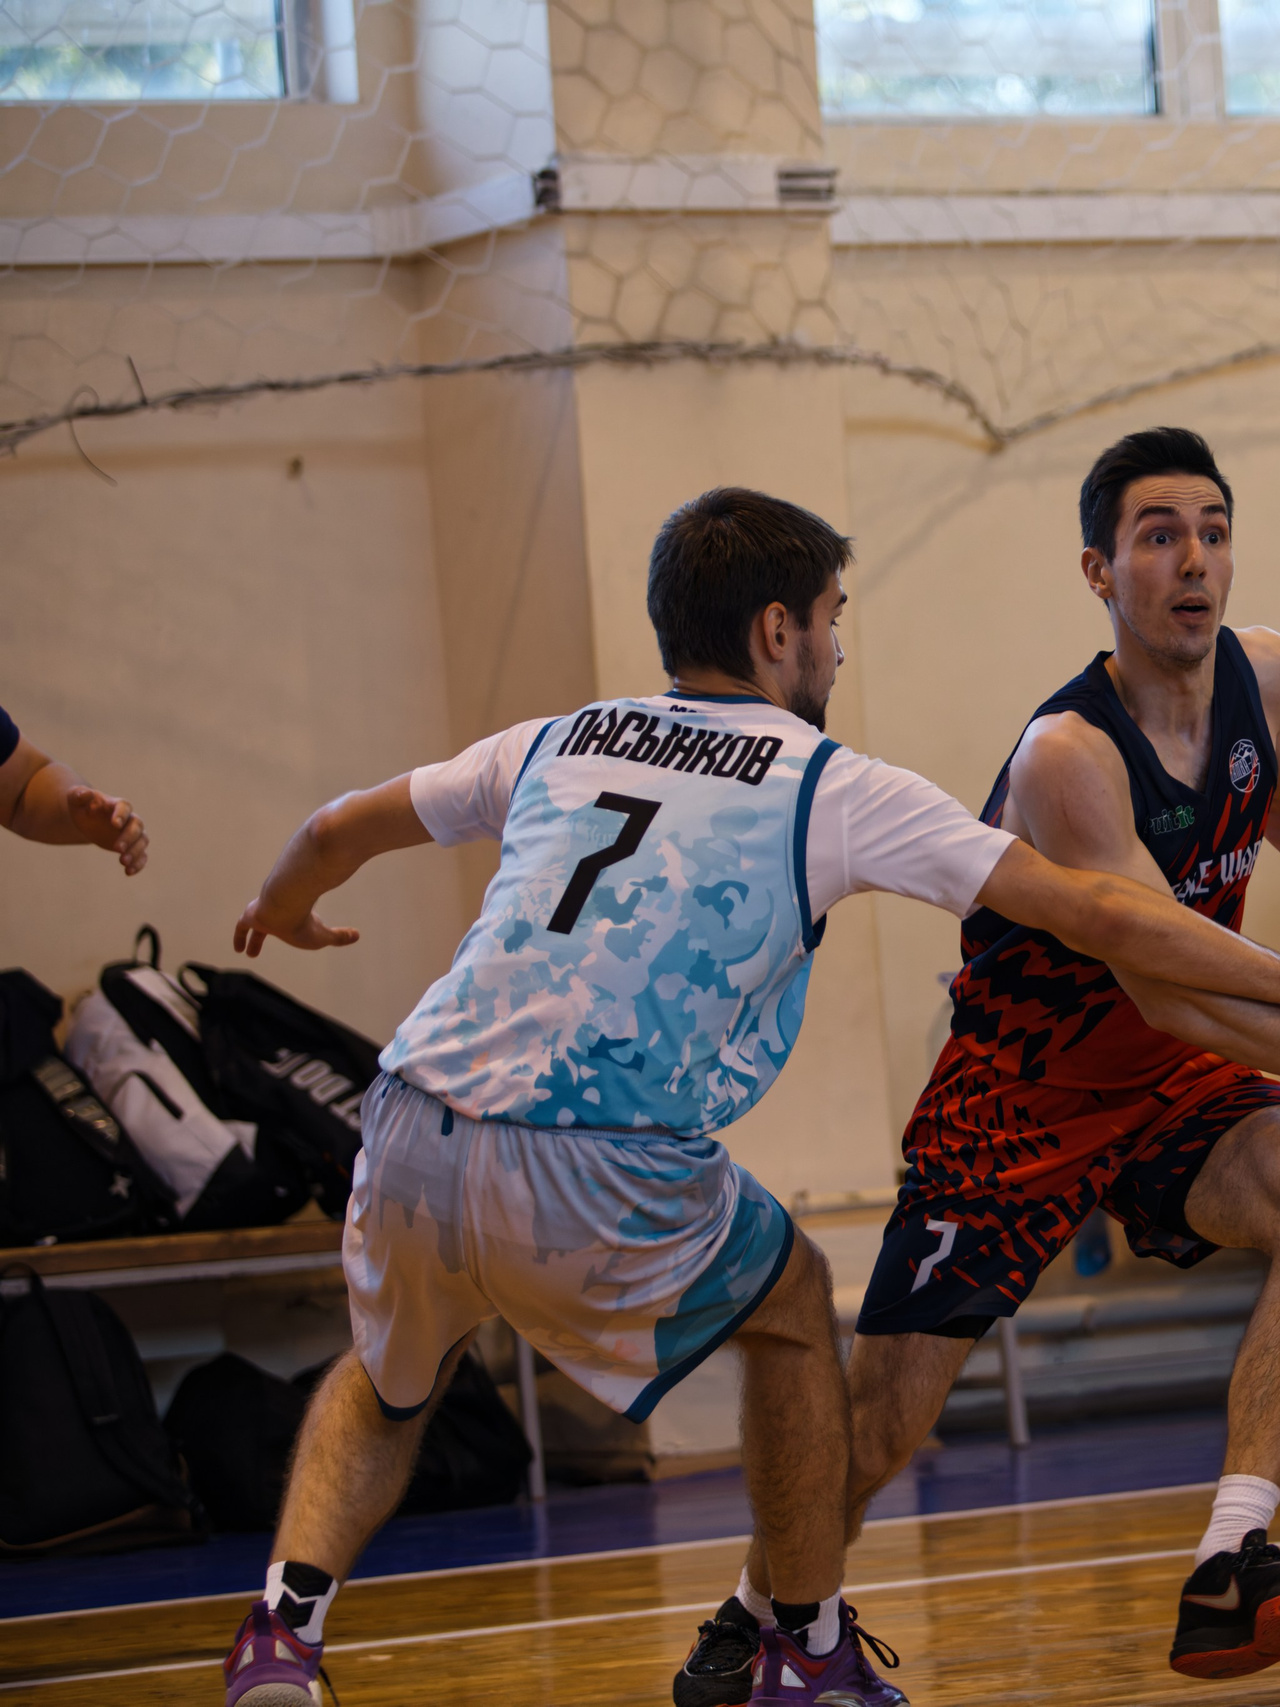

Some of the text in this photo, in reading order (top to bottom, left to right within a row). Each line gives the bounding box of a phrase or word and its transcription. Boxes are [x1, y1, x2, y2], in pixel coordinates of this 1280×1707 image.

[556, 707, 784, 787] ПАСЫНКОВ
[547, 791, 663, 935] 7
[911, 1219, 959, 1294] 7
